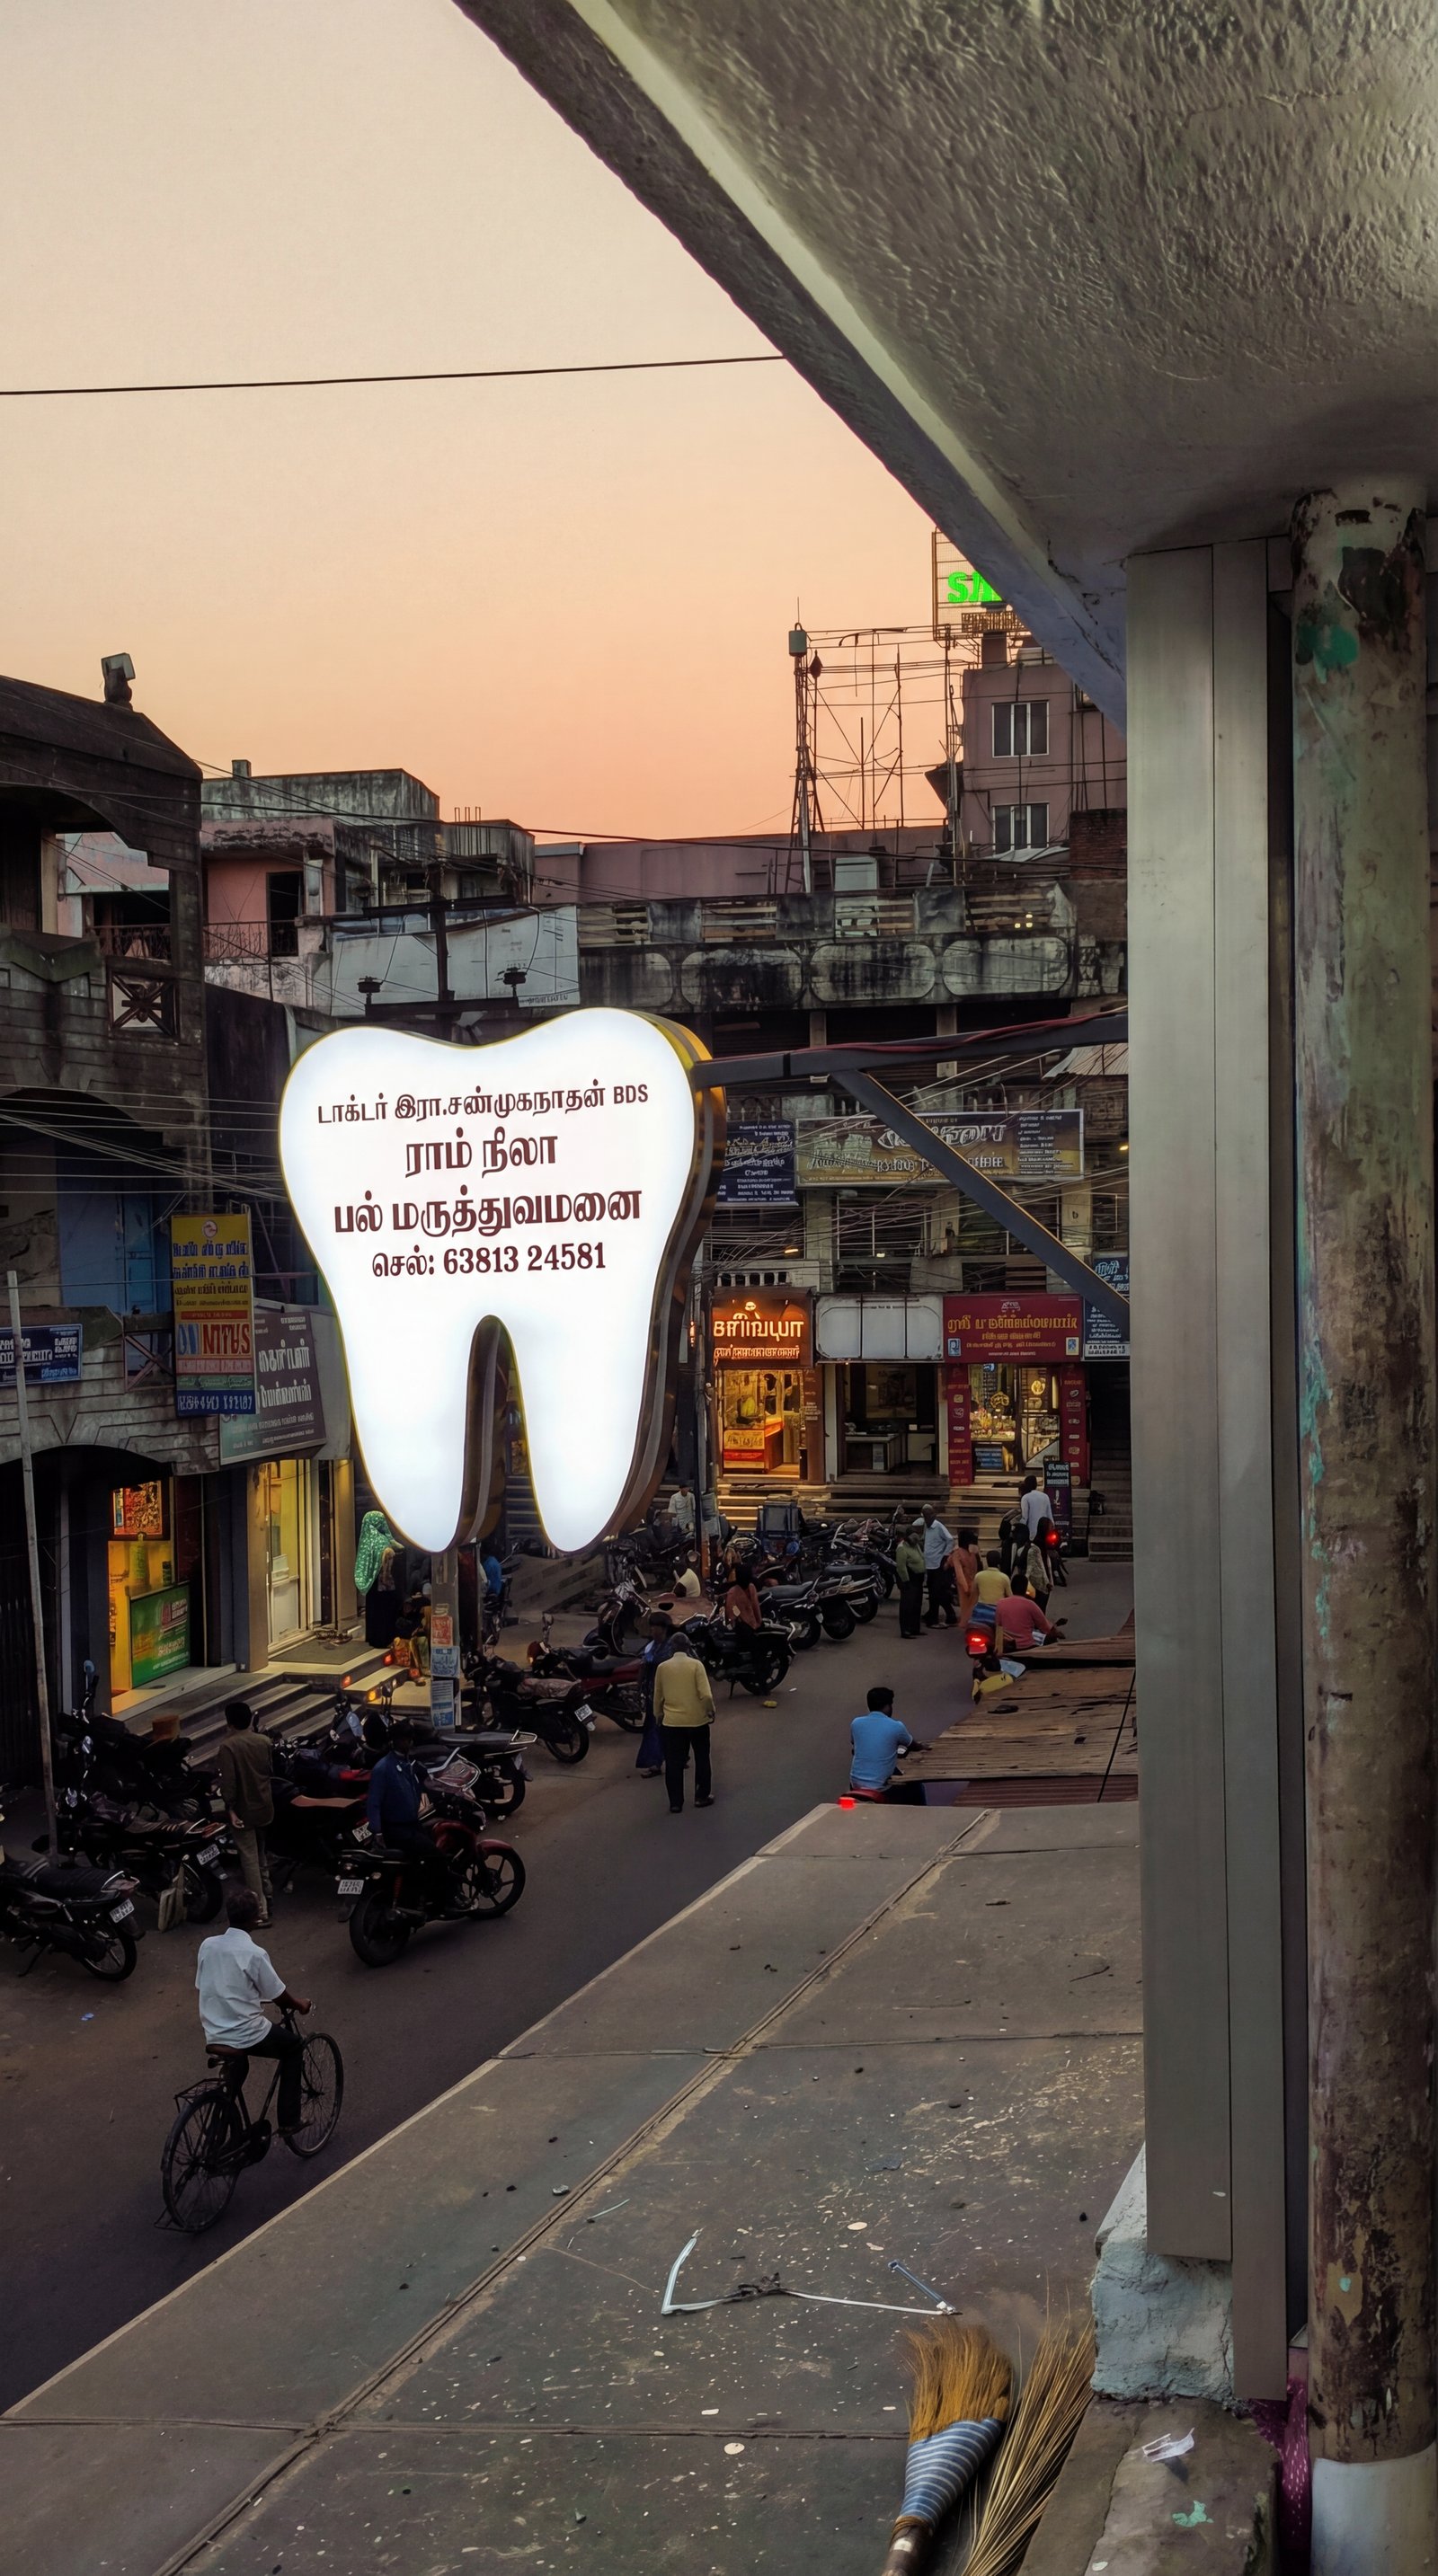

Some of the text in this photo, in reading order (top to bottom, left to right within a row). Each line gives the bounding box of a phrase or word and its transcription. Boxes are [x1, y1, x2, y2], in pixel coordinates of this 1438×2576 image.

[317, 1079, 649, 1124] டாக்டர் இரா.சண்முகநாதன் BDS
[404, 1126, 558, 1179] ராம் நிலா
[333, 1184, 643, 1238] பல் மருத்துவமனை
[371, 1242, 607, 1278] செல்: 63813 24581
